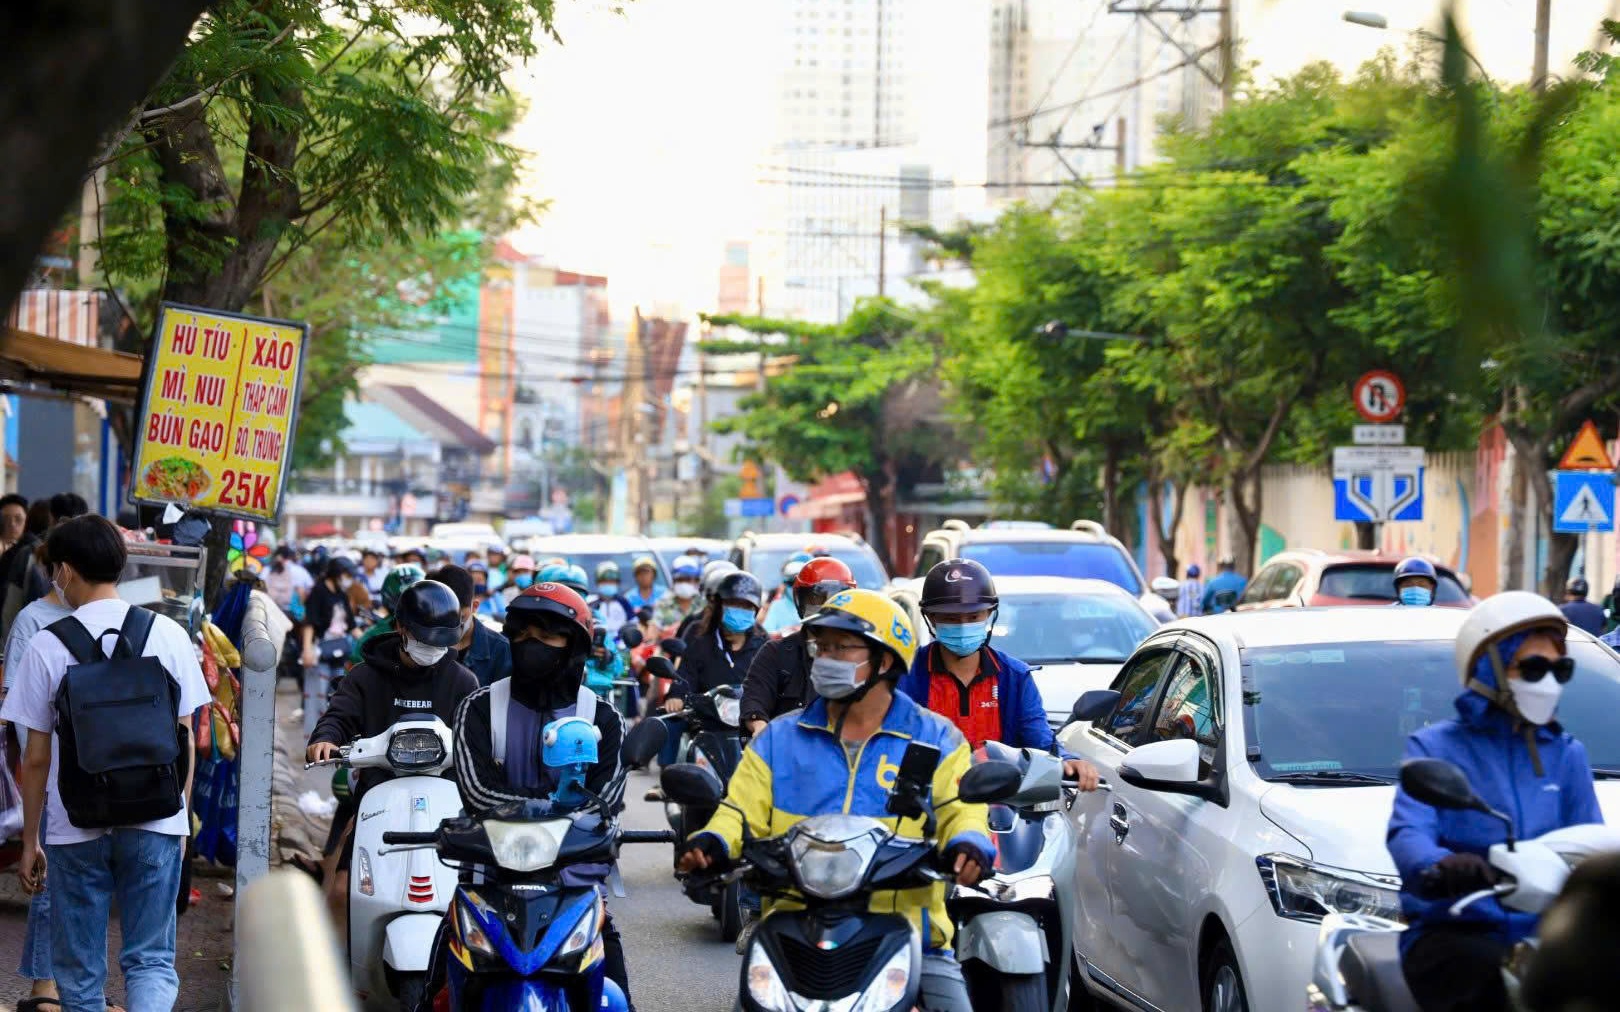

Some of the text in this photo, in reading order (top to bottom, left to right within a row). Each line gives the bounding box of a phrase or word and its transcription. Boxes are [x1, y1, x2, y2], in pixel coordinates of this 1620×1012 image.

[171, 317, 231, 361] HỦ TÍU
[251, 332, 294, 371] XÀO
[161, 364, 226, 407] MÌ, NUI
[147, 408, 224, 457] BÚN GẠO
[218, 469, 271, 510] 25K
[511, 884, 548, 892] HONDA
